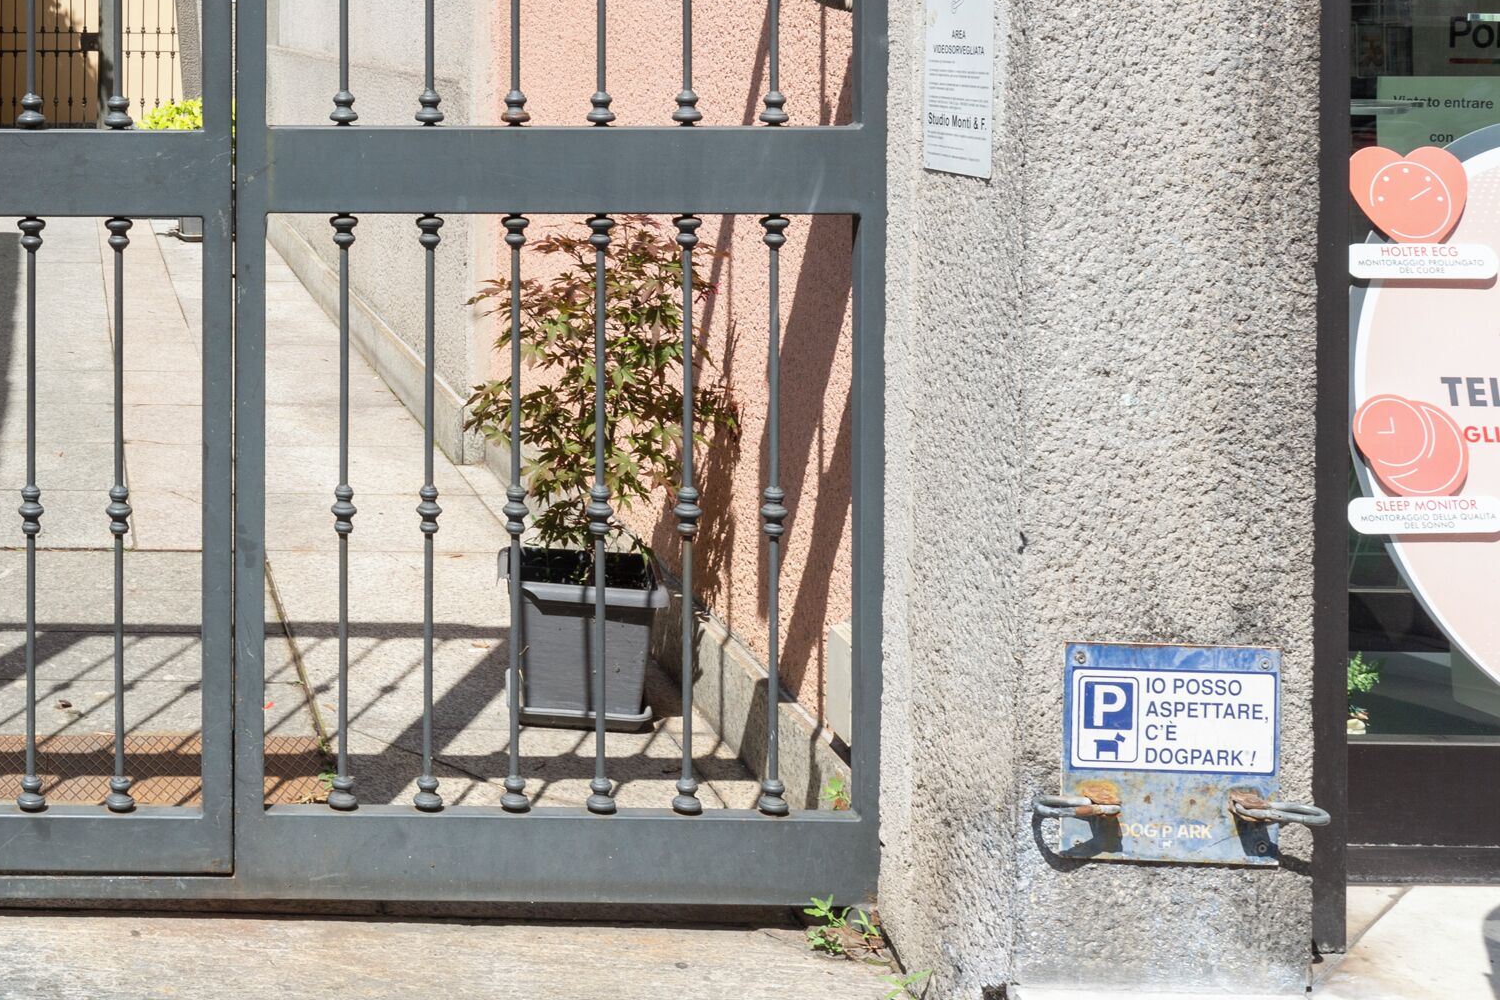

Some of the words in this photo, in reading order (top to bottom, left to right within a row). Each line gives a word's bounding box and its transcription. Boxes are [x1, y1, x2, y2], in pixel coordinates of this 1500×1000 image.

[952, 30, 966, 39] AREA
[933, 45, 984, 55] VIDEOSORVEGLIATA
[1444, 97, 1493, 109] entrare
[928, 112, 949, 126] Studio
[952, 115, 971, 128] Monti
[974, 117, 979, 130] &
[981, 118, 986, 130] F.
[1430, 133, 1453, 143] con
[1381, 247, 1427, 257] HOLTER
[1432, 247, 1458, 257] ECG
[1376, 500, 1410, 511] SLEEP
[1415, 500, 1478, 511] MONITOR
[1361, 514, 1427, 522] MONITORAGGIO
[1146, 678, 1166, 694] IO
[1173, 678, 1242, 696] POSSO
[1093, 685, 1127, 727] P
[1146, 701, 1268, 723] ASPETTARE,
[1145, 721, 1177, 741] C'È
[1145, 748, 1243, 766] DOGPARK
[1250, 751, 1256, 766] !
